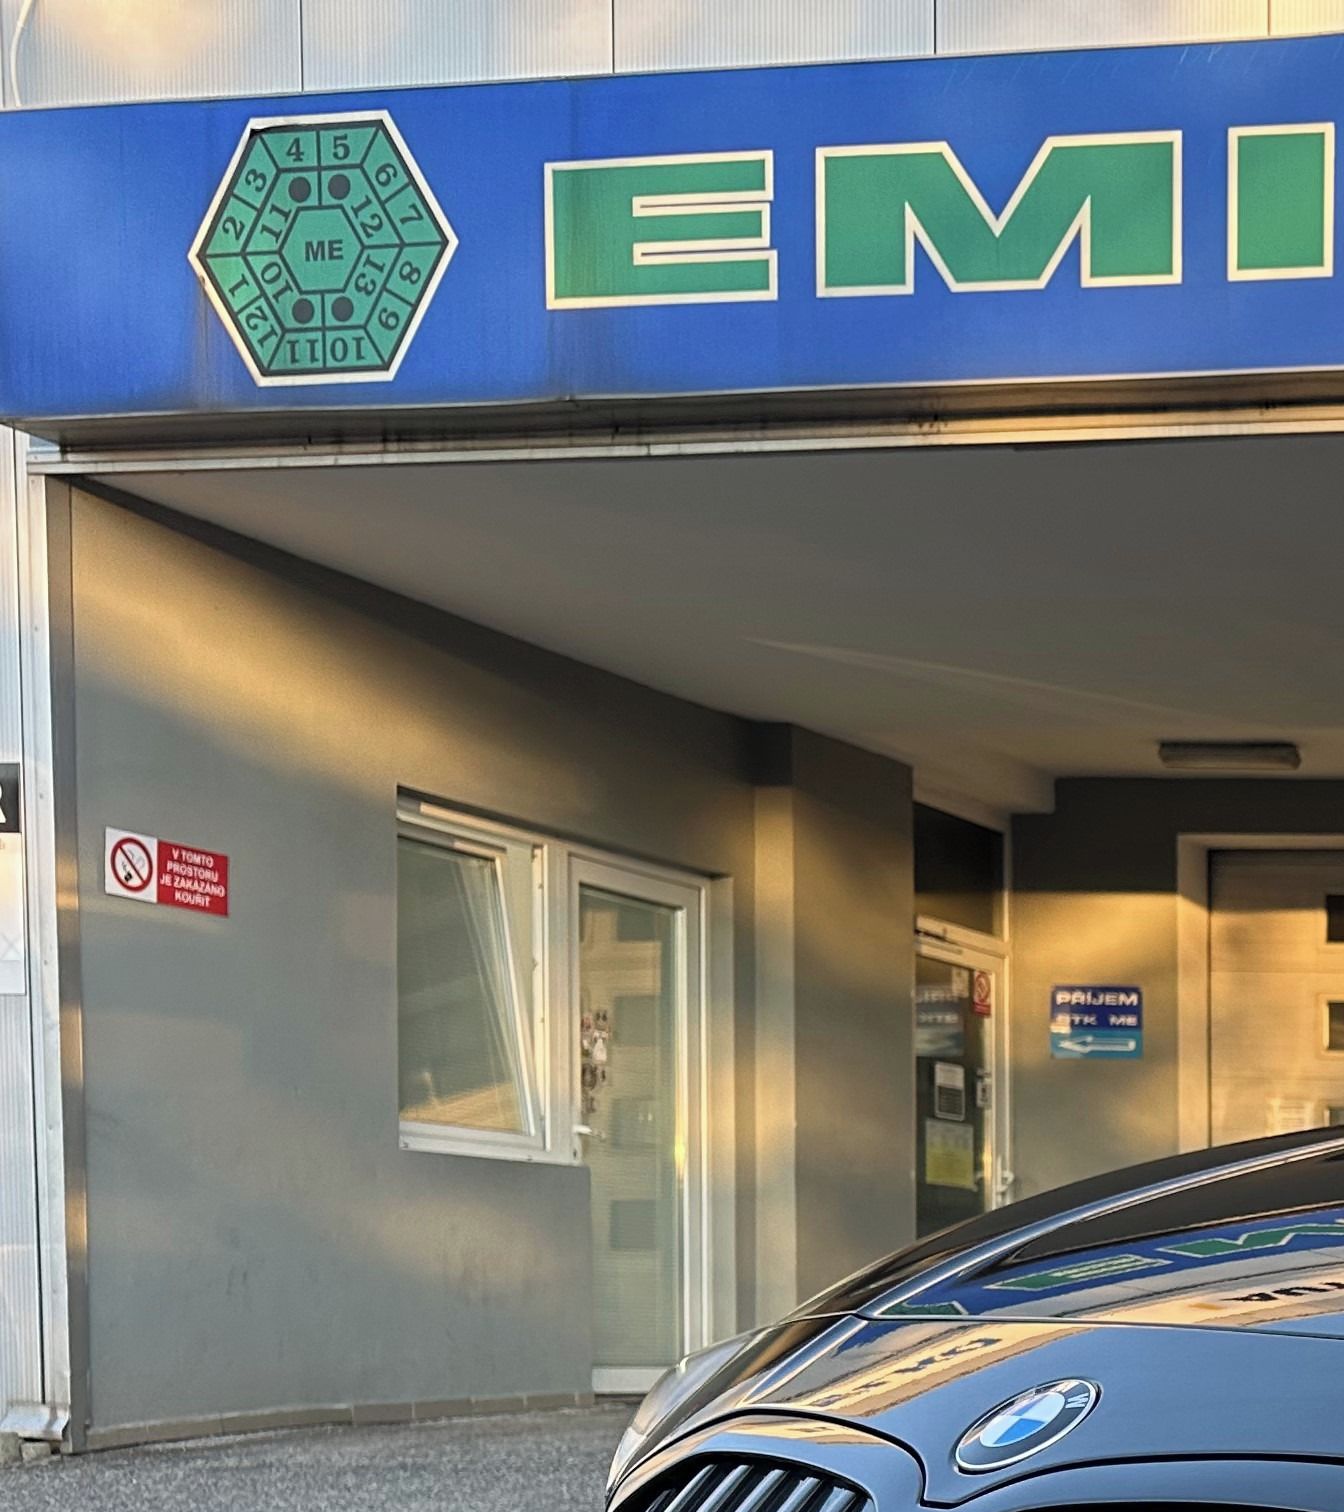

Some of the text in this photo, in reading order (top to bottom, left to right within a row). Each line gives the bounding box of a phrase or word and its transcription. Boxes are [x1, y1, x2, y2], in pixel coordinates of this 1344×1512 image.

[286, 137, 305, 162] 4
[332, 134, 351, 161] 5
[245, 169, 268, 193] 3
[375, 163, 398, 187] 6
[400, 203, 423, 226] 7
[222, 215, 245, 241] 2
[304, 240, 344, 262] ME
[400, 261, 421, 285] 8
[172, 848, 214, 868] V TOMTO
[159, 873, 172, 886] JE
[166, 860, 219, 882] PROSTORU
[1055, 1012, 1138, 1026] STK ME
